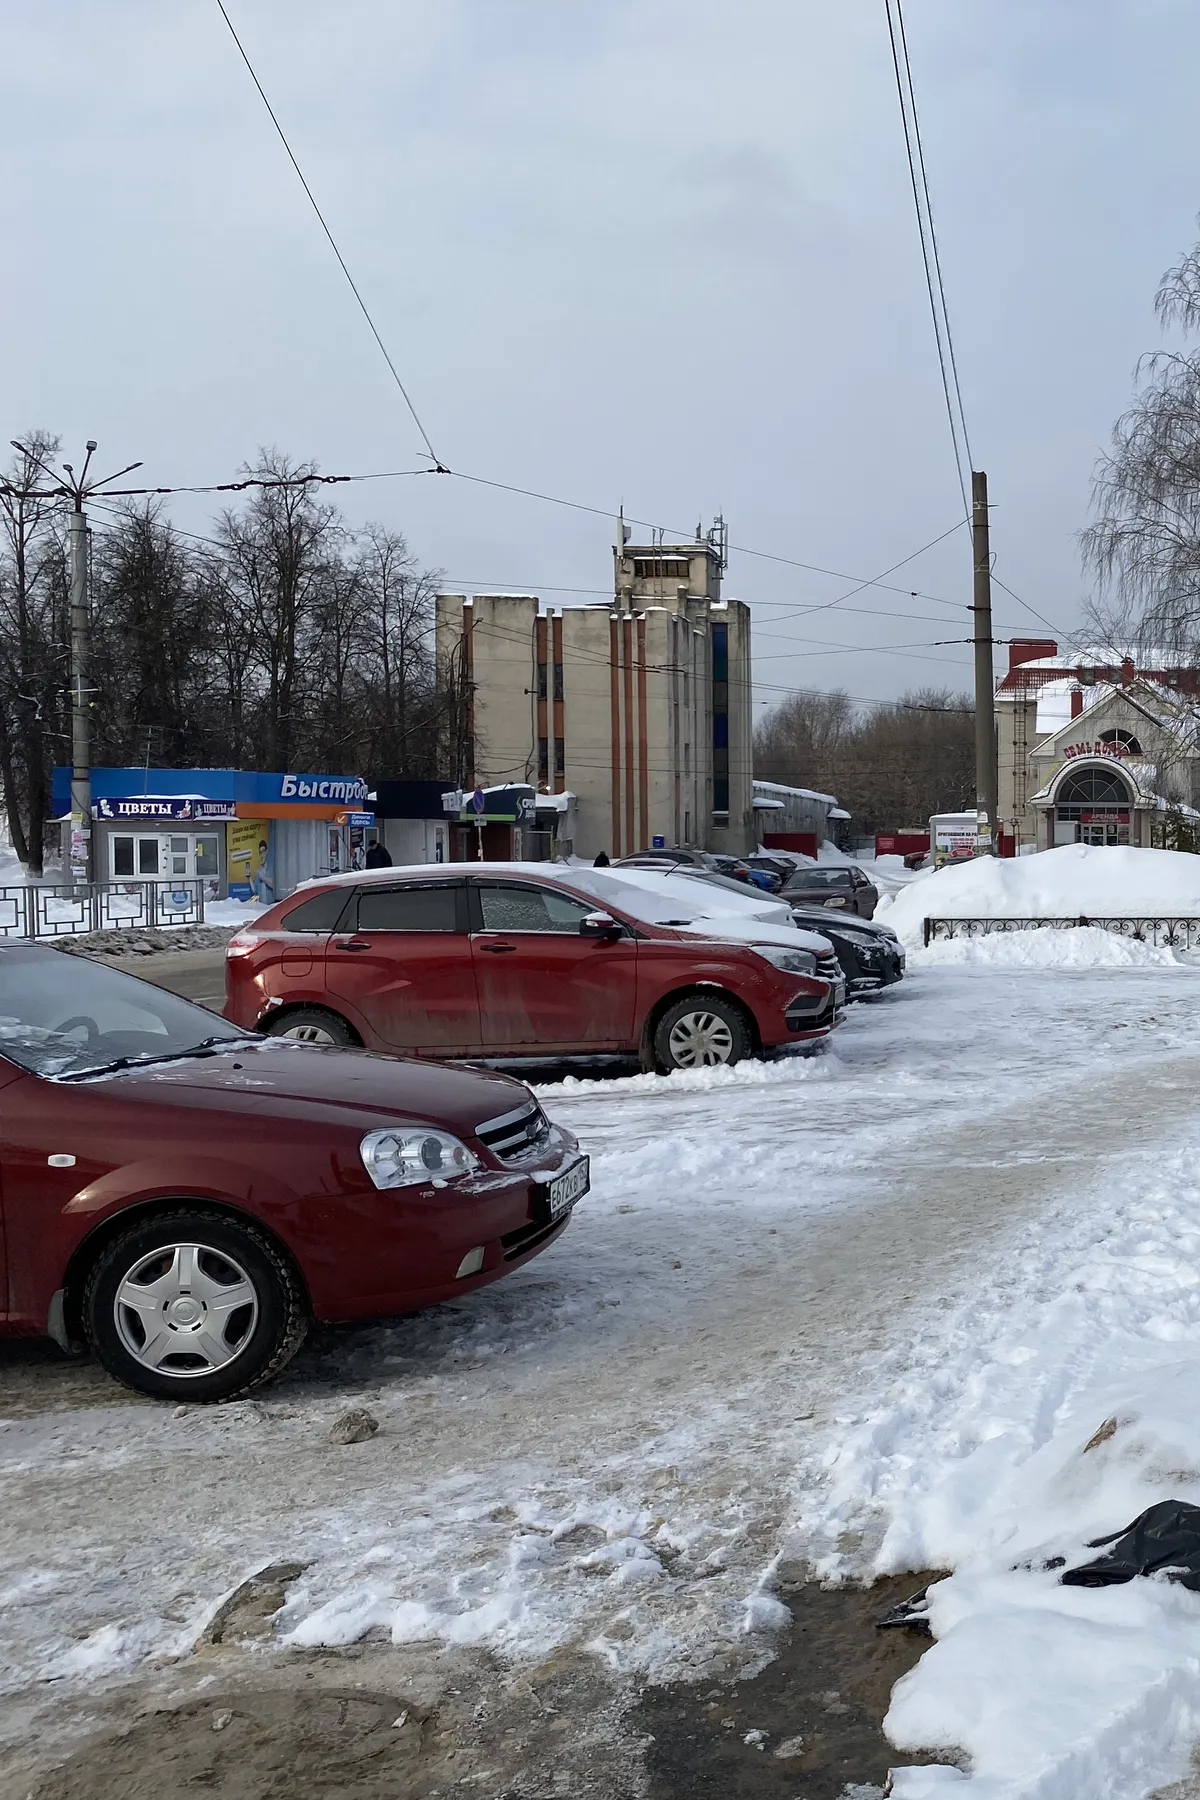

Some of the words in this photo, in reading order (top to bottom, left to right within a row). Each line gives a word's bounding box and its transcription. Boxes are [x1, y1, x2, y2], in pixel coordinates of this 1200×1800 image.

[1063, 742, 1092, 759] СЕМЬ
[118, 802, 172, 816] ЦВЕТЫ
[203, 803, 227, 814] ЦВЕТЫ
